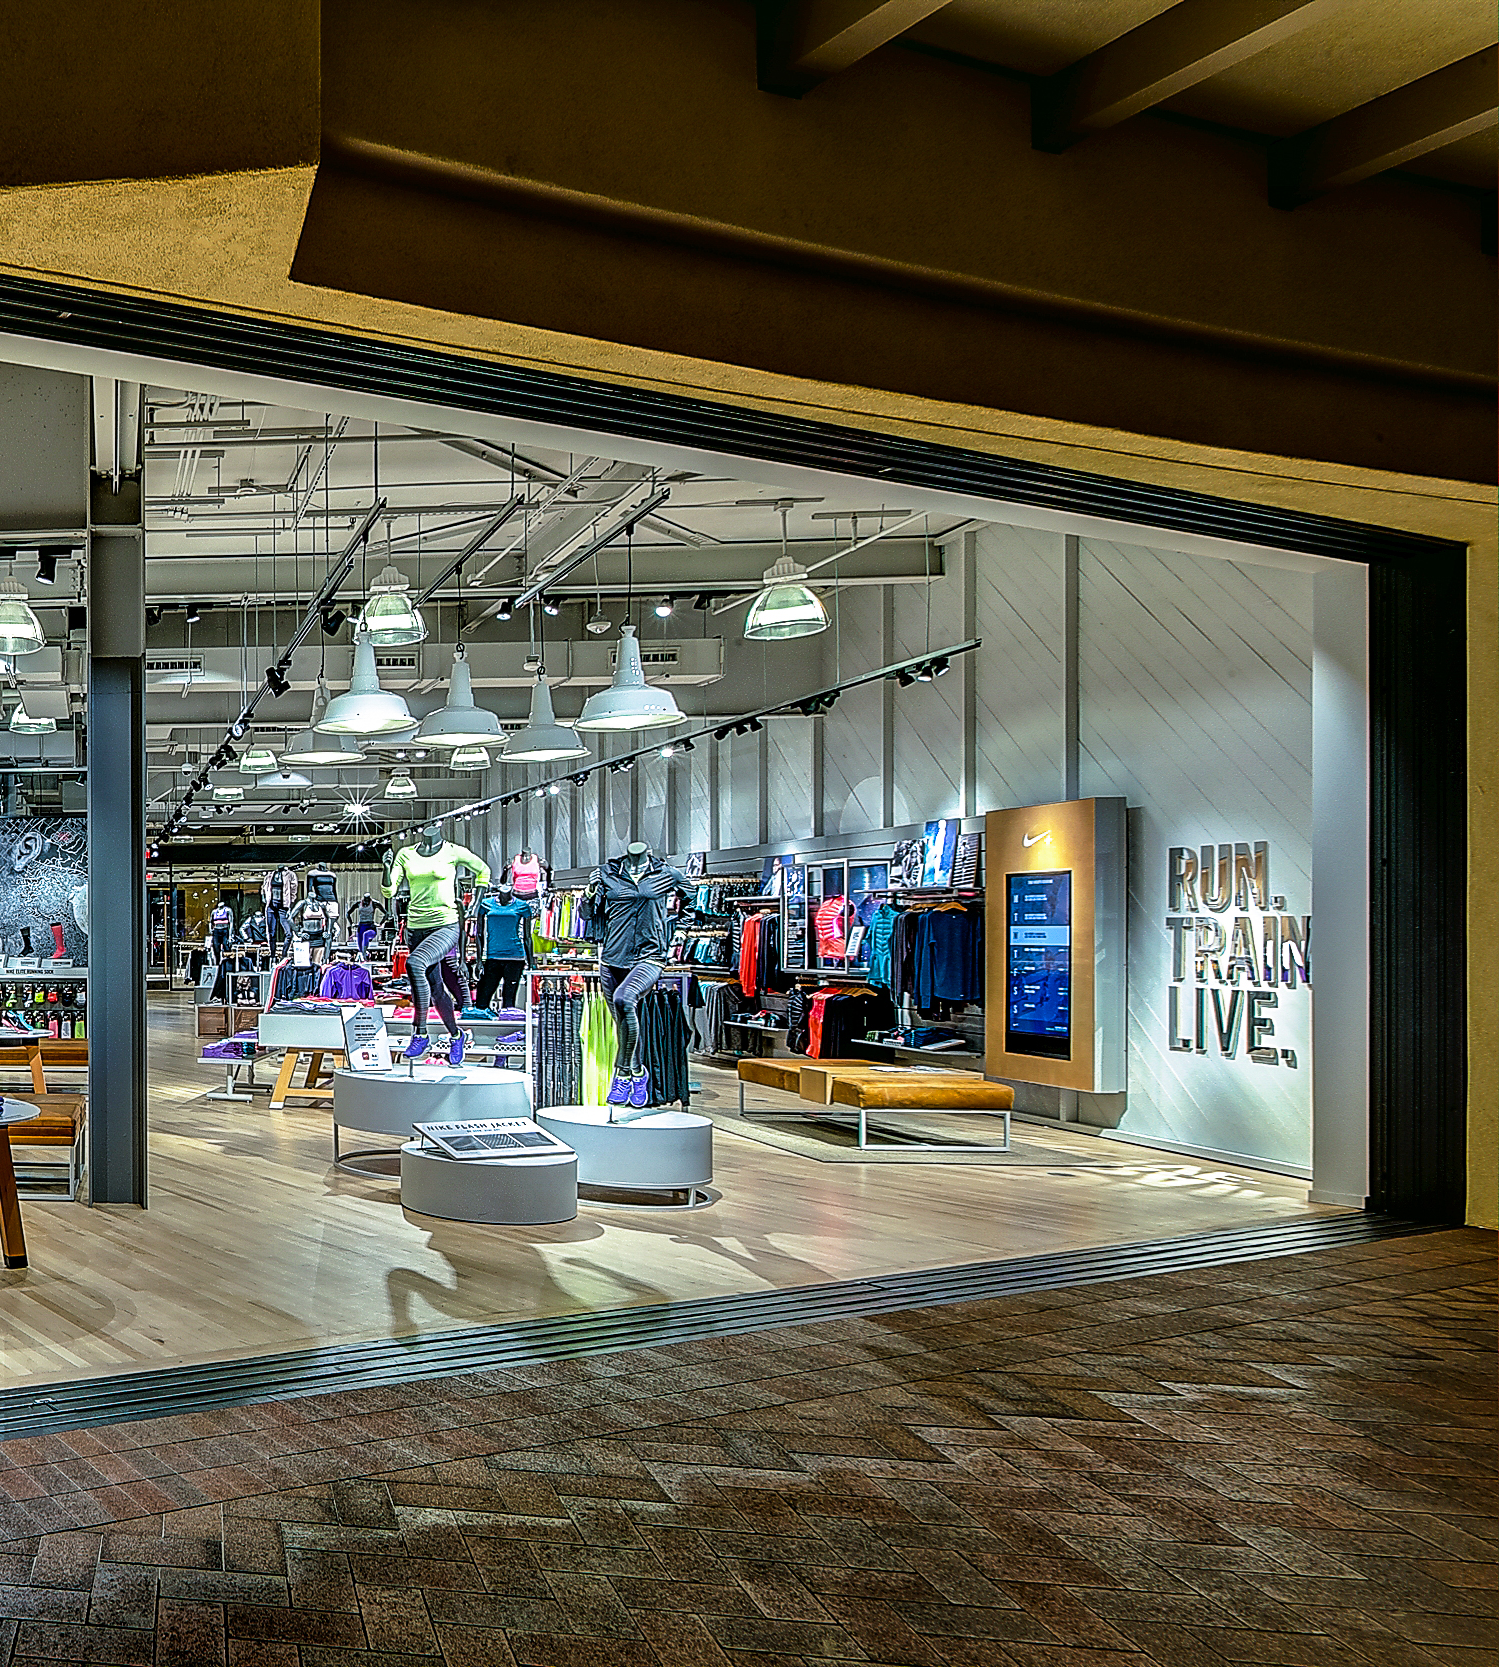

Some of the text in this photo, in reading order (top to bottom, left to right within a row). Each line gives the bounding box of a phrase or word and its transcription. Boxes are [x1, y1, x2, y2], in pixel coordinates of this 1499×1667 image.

[1167, 841, 1287, 912] RUN.
[1165, 915, 1312, 989] TRAIN
[1167, 985, 1298, 1068] LIVE.
[426, 1121, 527, 1132] NIKE FLASH JACKET
